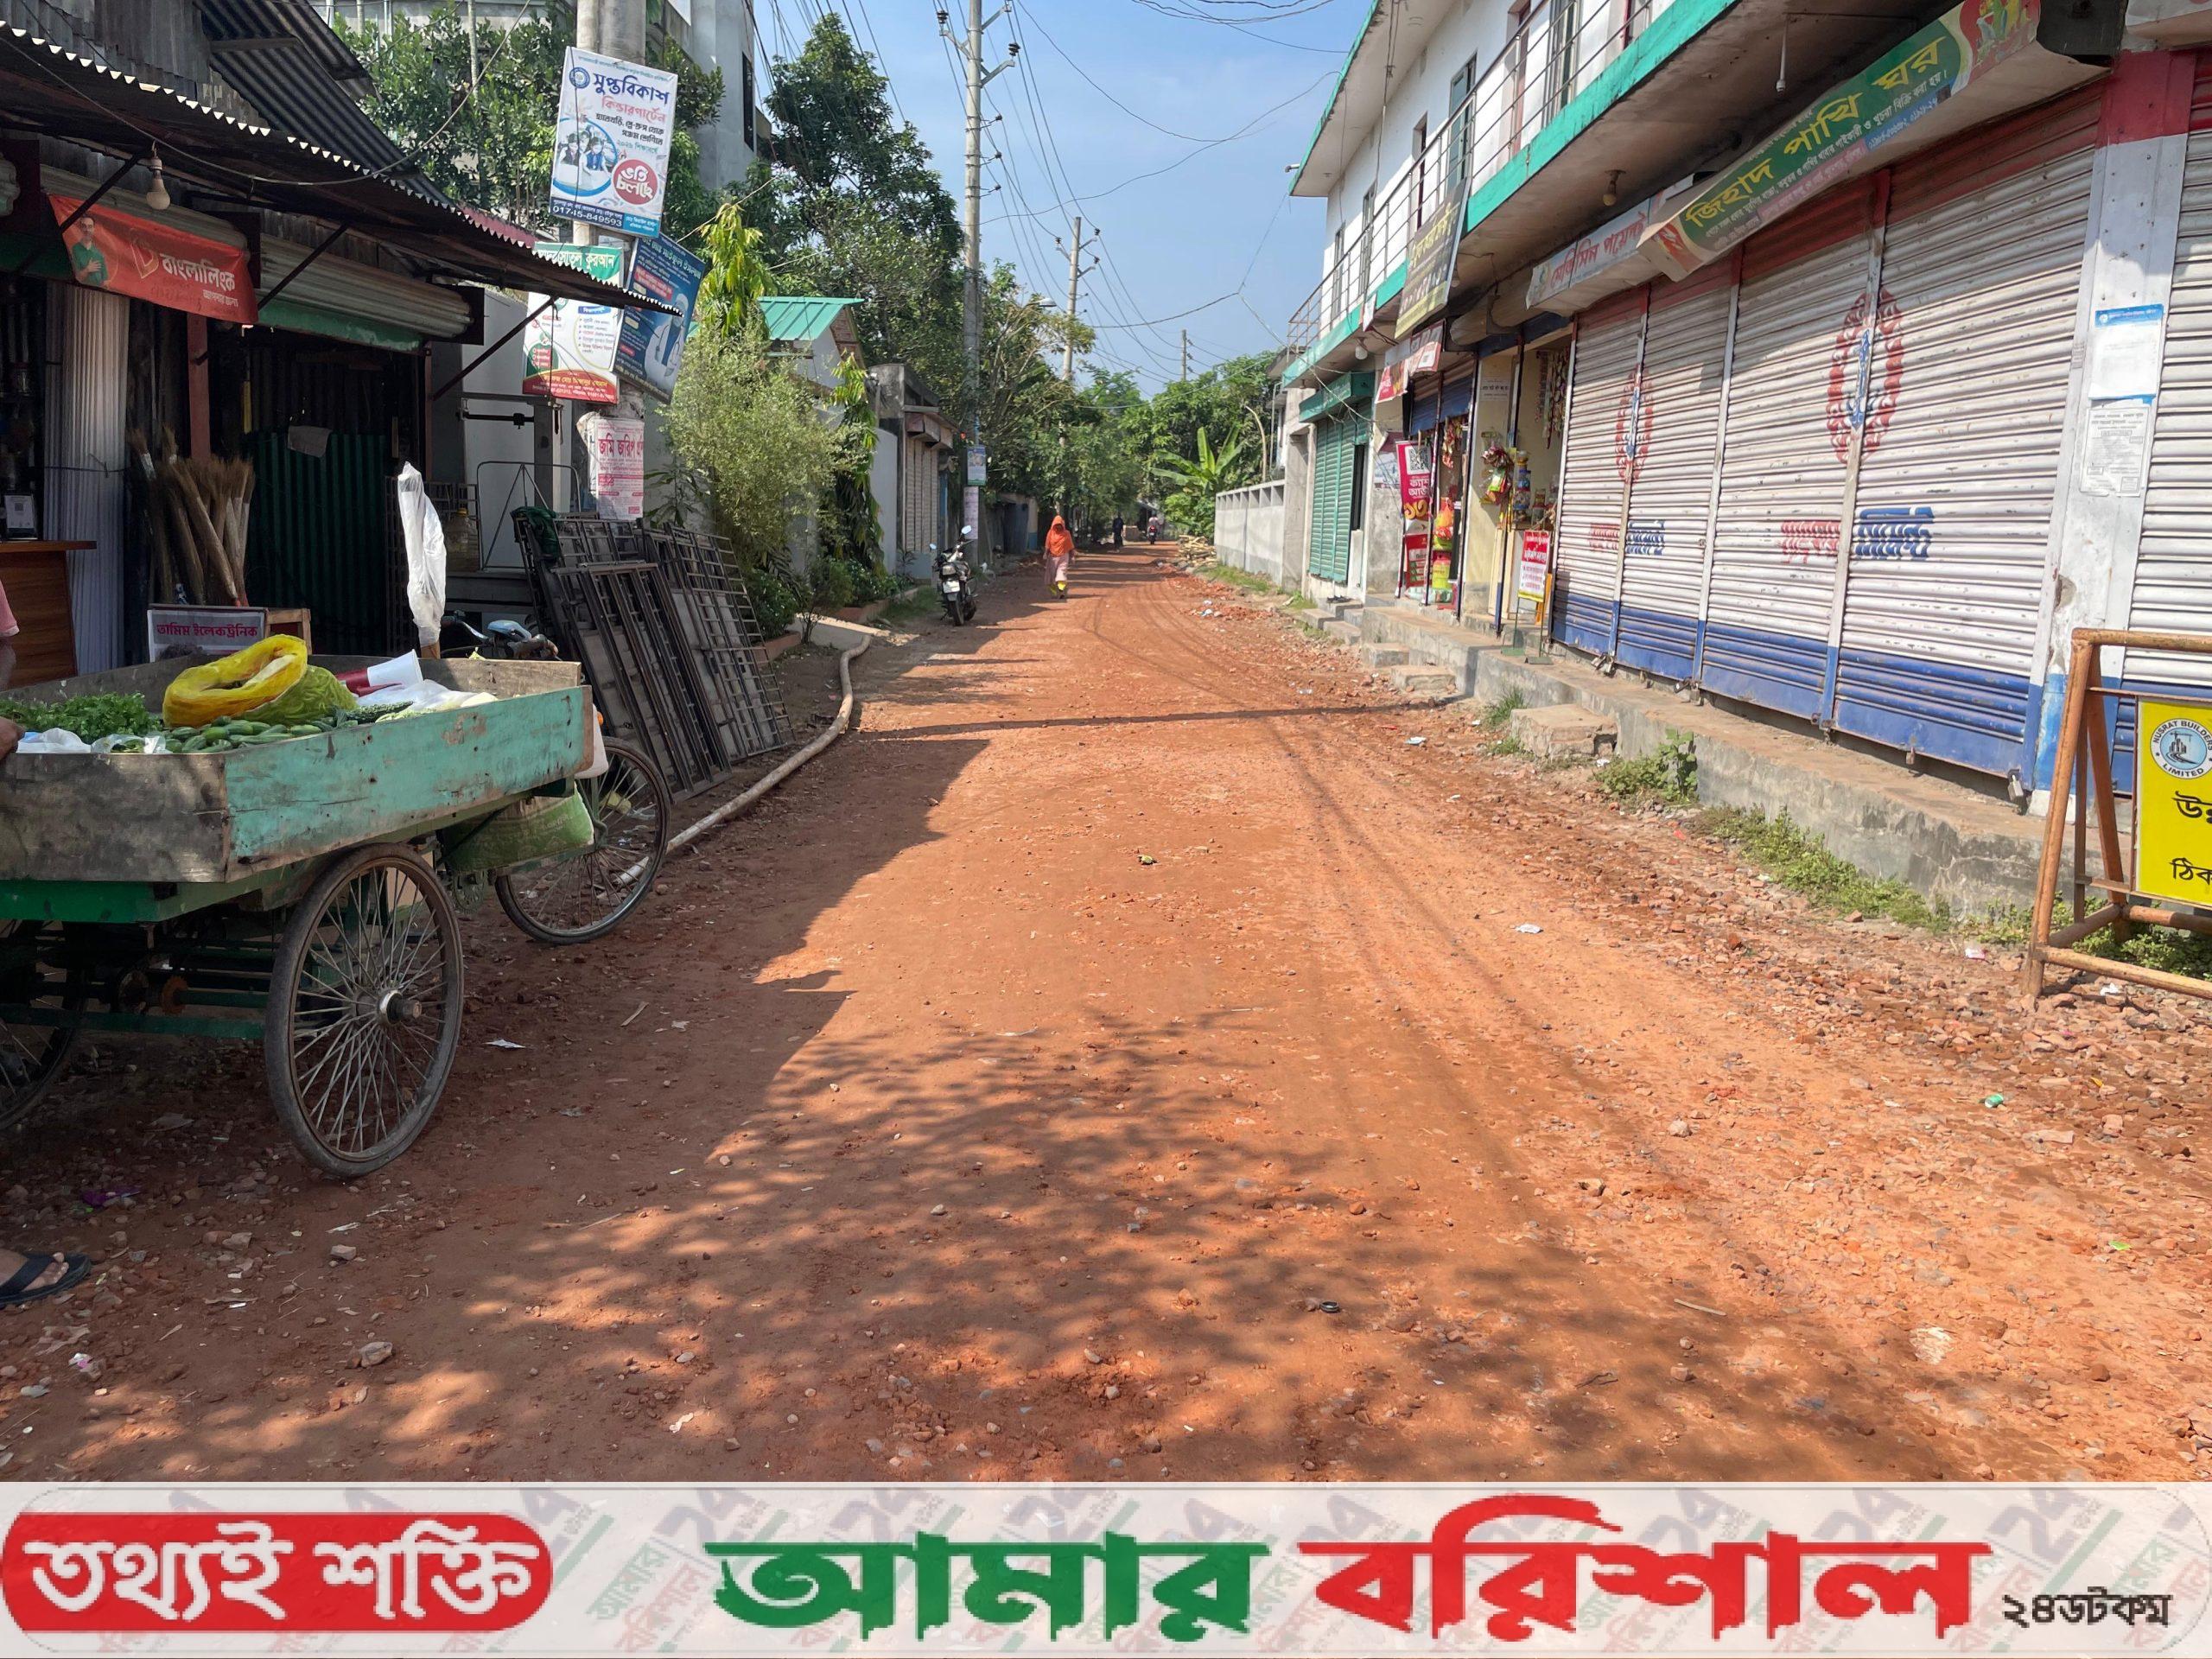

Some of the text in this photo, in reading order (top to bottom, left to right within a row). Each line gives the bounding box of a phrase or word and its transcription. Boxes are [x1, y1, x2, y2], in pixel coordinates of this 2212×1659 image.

[1686, 158, 1774, 227] জিহাদ
[1784, 92, 1863, 155] পাখি
[1872, 35, 1946, 90] ঘর
[159, 253, 235, 291] বাংলালিংক
[2152, 720, 2212, 751] NUSRAT BUILDERS
[2162, 762, 2204, 778] LIMITED
